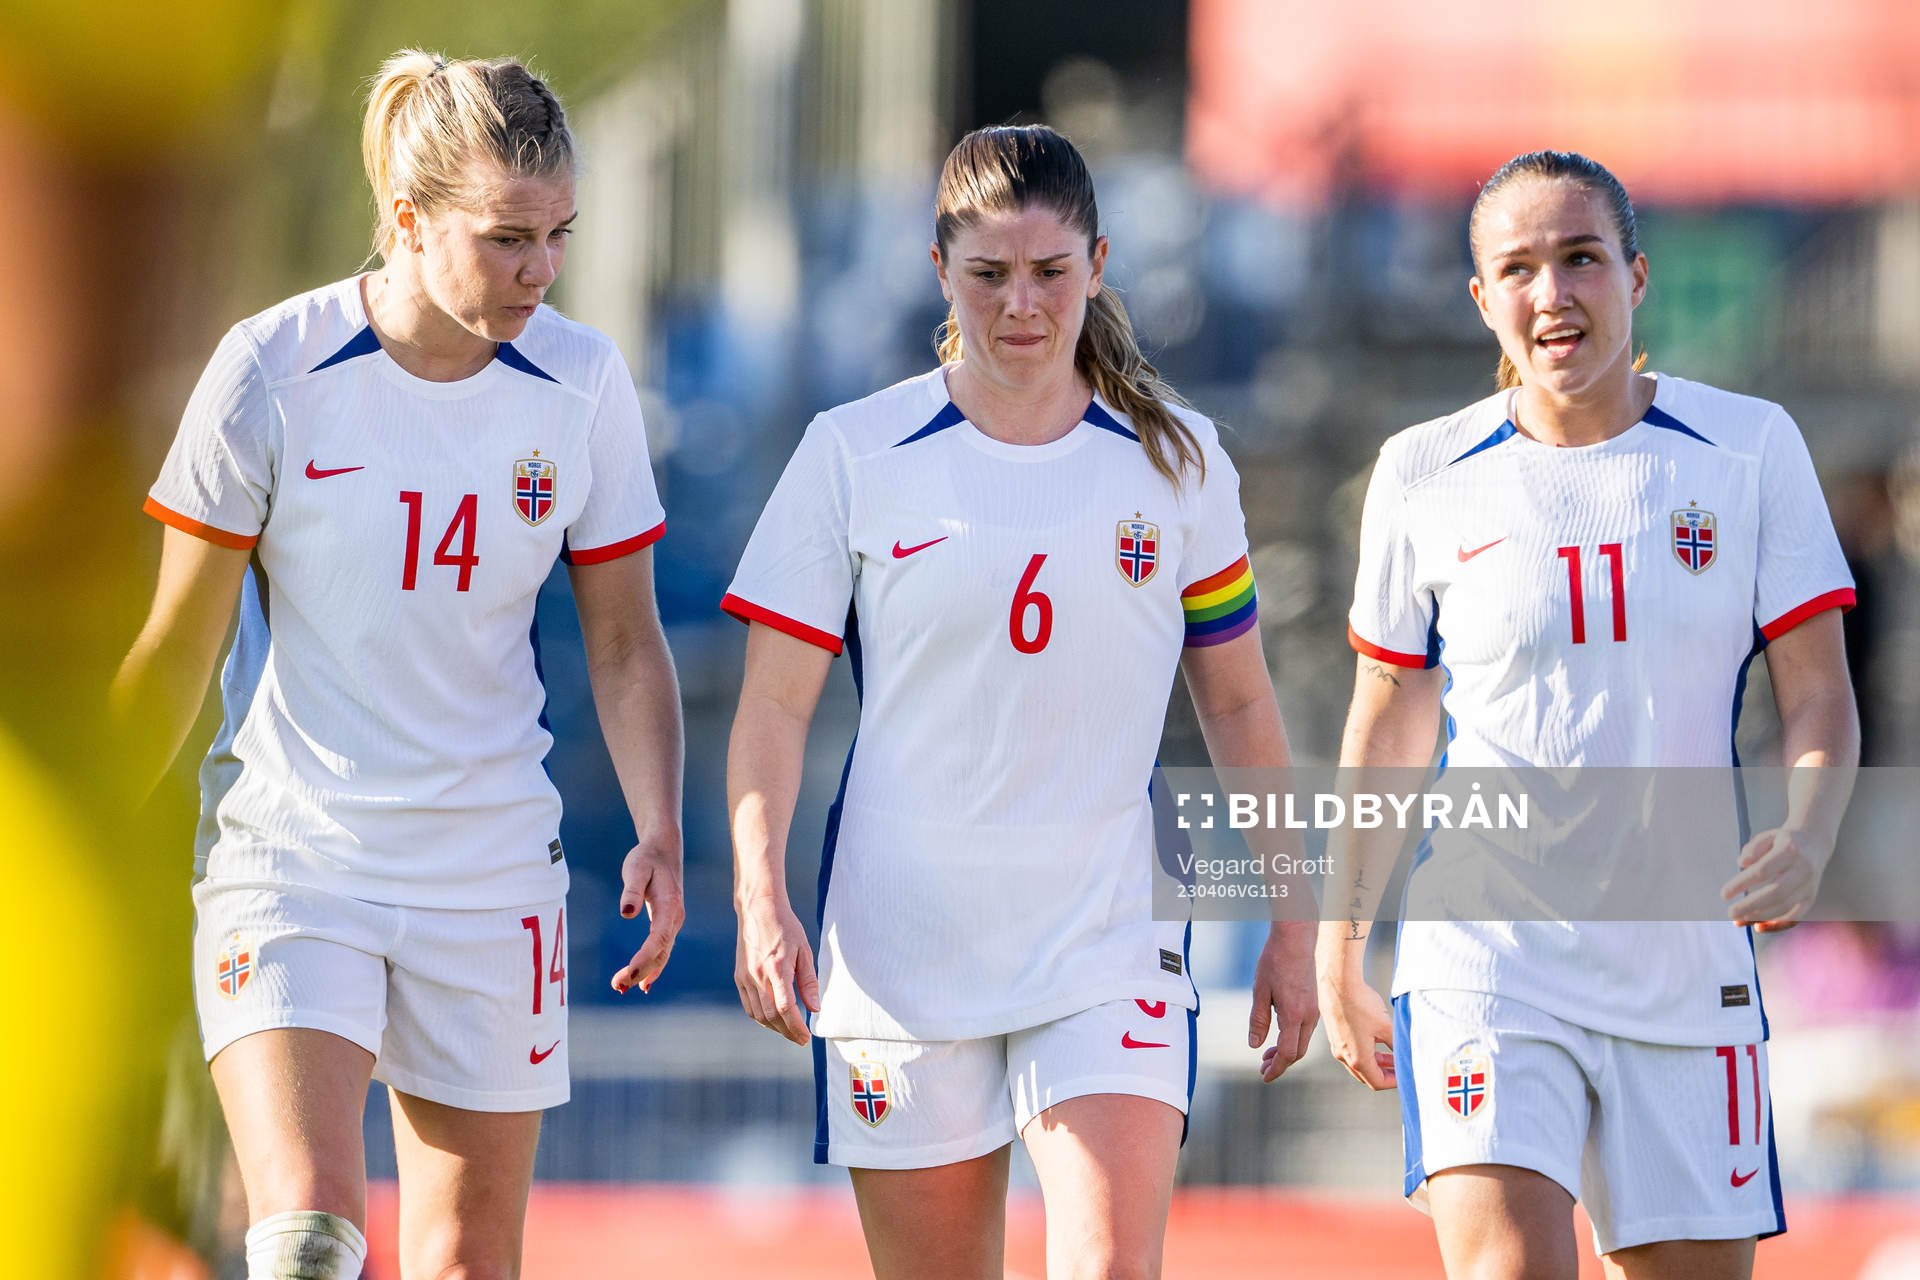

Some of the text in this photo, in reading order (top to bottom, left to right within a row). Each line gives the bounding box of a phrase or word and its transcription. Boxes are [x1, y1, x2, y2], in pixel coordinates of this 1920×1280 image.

[399, 490, 480, 592] 14
[1009, 553, 1053, 654] 6
[1557, 543, 1627, 644] 11
[520, 907, 565, 1015] 14
[1715, 1044, 1761, 1146] 11
